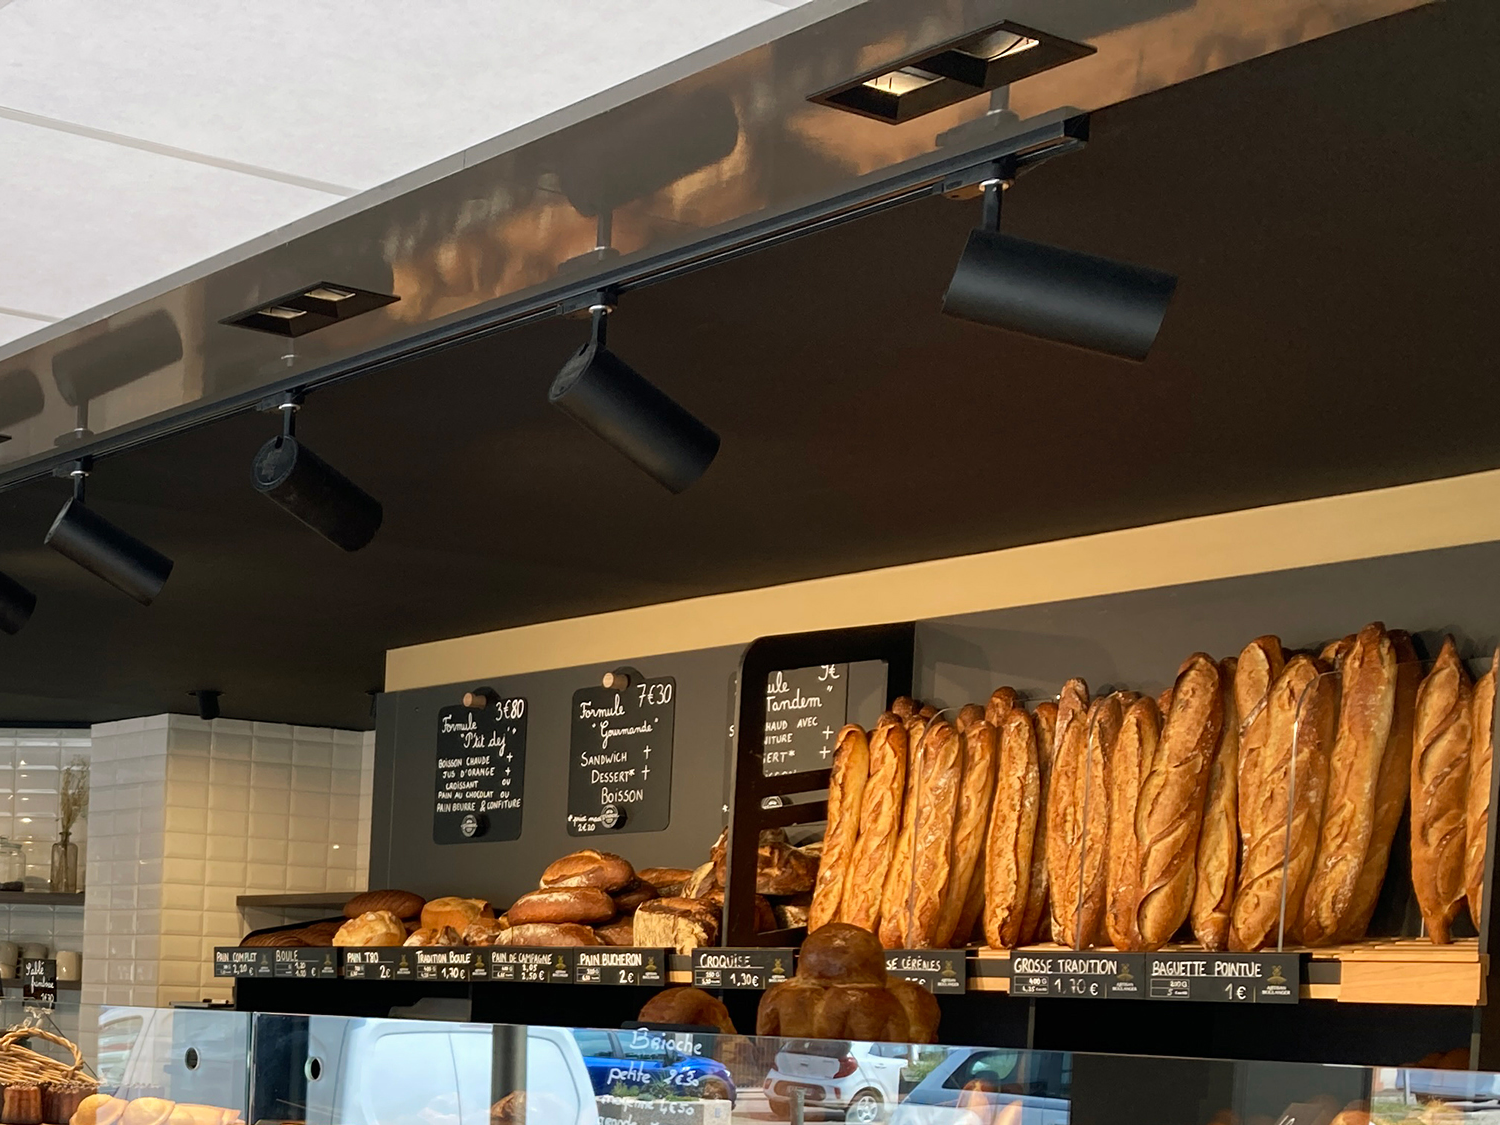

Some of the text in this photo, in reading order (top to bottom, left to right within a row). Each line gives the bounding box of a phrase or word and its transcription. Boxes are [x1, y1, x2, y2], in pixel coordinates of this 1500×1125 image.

[637, 683, 673, 708] 7€30
[495, 698, 525, 722] 3€80
[579, 693, 626, 719] Formule
[441, 712, 478, 734] Formule
[765, 717, 819, 732] HAUD AVEC
[466, 755, 491, 766] CHAUDE
[442, 770, 456, 779] JUS
[460, 766, 496, 778] D'ORANGE
[438, 790, 510, 799] PAIN AU CHOCOLAT OU
[436, 803, 451, 813] PAIN
[452, 801, 476, 812] BEURRE
[216, 951, 258, 963] PAIN COMPLET
[275, 949, 299, 963] BOULE
[346, 951, 380, 964] PAIN T80
[491, 951, 553, 965] PAIN DE CAMPAGNE
[580, 952, 642, 967] PAIN BUCHERON
[379, 964, 391, 979] 2€
[1013, 958, 1117, 974] GROSSE TRADITION
[1152, 961, 1263, 978] BAGUETTE POINTUE
[619, 969, 634, 984] 2€
[729, 972, 759, 987] 1,30€
[606, 1060, 651, 1085] petite
